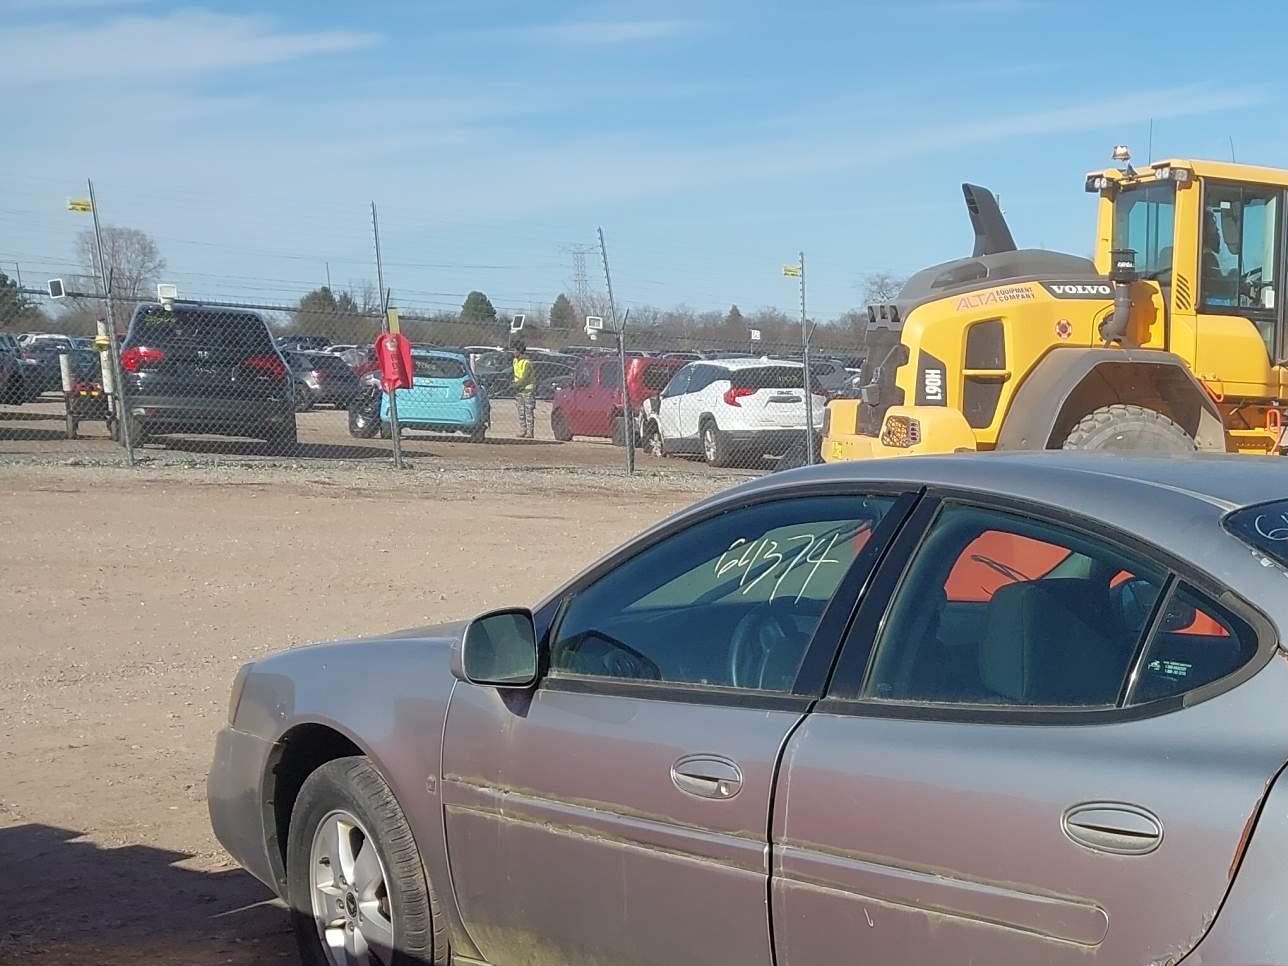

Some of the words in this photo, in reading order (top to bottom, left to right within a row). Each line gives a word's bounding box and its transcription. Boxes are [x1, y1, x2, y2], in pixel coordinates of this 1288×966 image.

[996, 287, 1034, 297] EQUIPMENT
[998, 293, 1035, 302] COMPANY
[1050, 285, 1110, 295] VOLVO
[956, 292, 998, 312] ALTA
[924, 369, 942, 401] L90H
[714, 533, 840, 608] 64374
